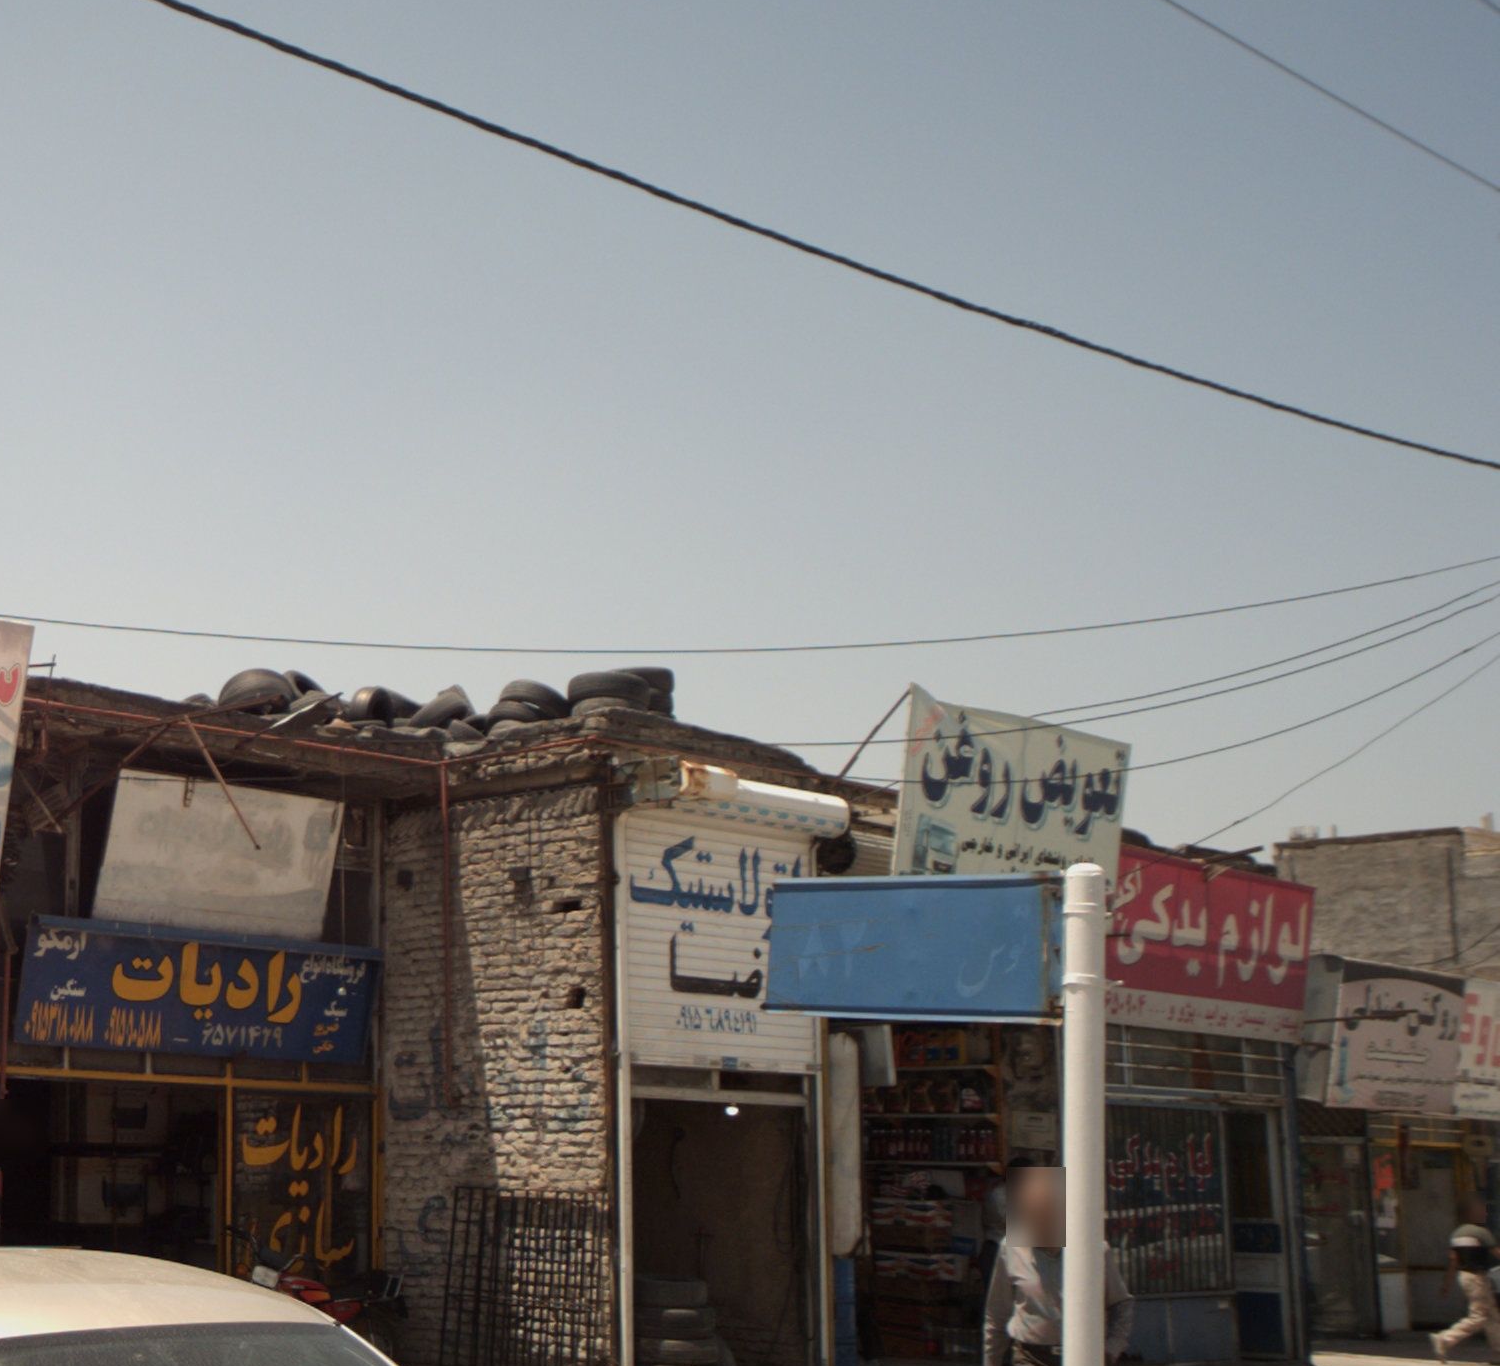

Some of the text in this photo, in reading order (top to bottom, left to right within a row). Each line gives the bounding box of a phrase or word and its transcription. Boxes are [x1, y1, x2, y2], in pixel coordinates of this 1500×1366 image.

[921, 710, 1011, 820] روغن
[1021, 734, 1127, 836] تعویض
[1117, 883, 1208, 977] یدکی
[1217, 892, 1309, 989] لوازم
[111, 941, 302, 1024] رادیات
[242, 1103, 358, 1198] رادیات
